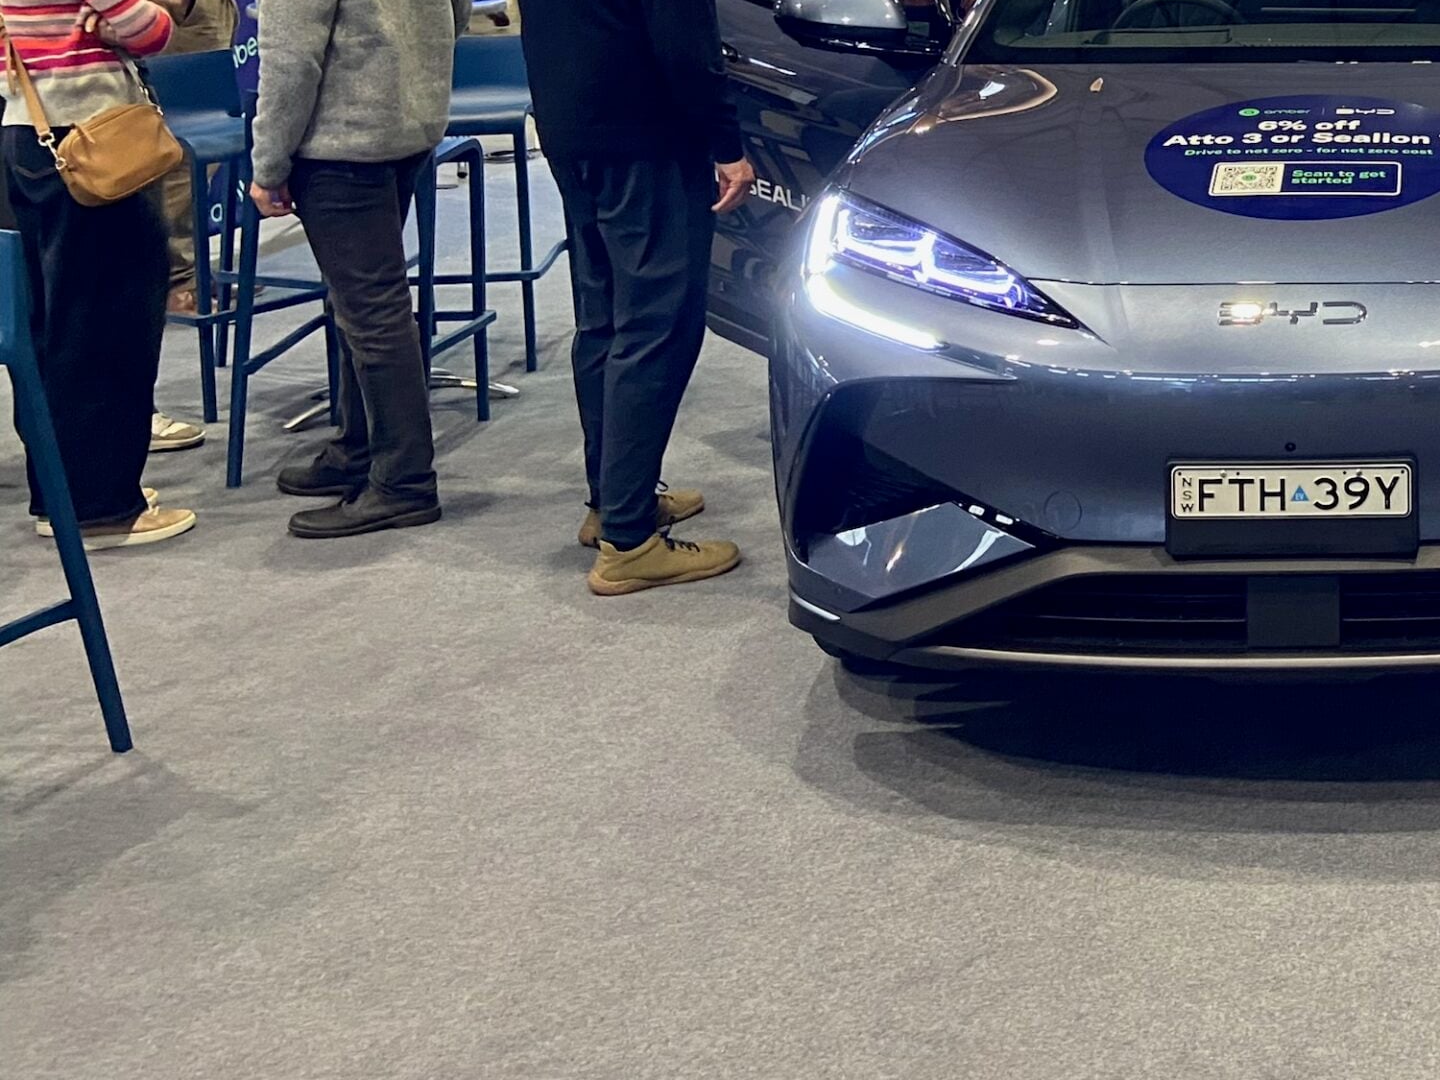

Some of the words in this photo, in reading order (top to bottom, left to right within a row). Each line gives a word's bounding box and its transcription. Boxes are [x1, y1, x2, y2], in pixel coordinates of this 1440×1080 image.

[1258, 120, 1307, 131] 6%
[1315, 120, 1360, 130] off
[1162, 133, 1234, 146] Atto
[1242, 133, 1262, 144] 3
[1270, 134, 1305, 144] or
[1316, 147, 1337, 155] for
[1292, 170, 1333, 178] Scan
[1338, 170, 1355, 178] to
[1359, 170, 1386, 179] get
[1218, 301, 1368, 326] BYD
